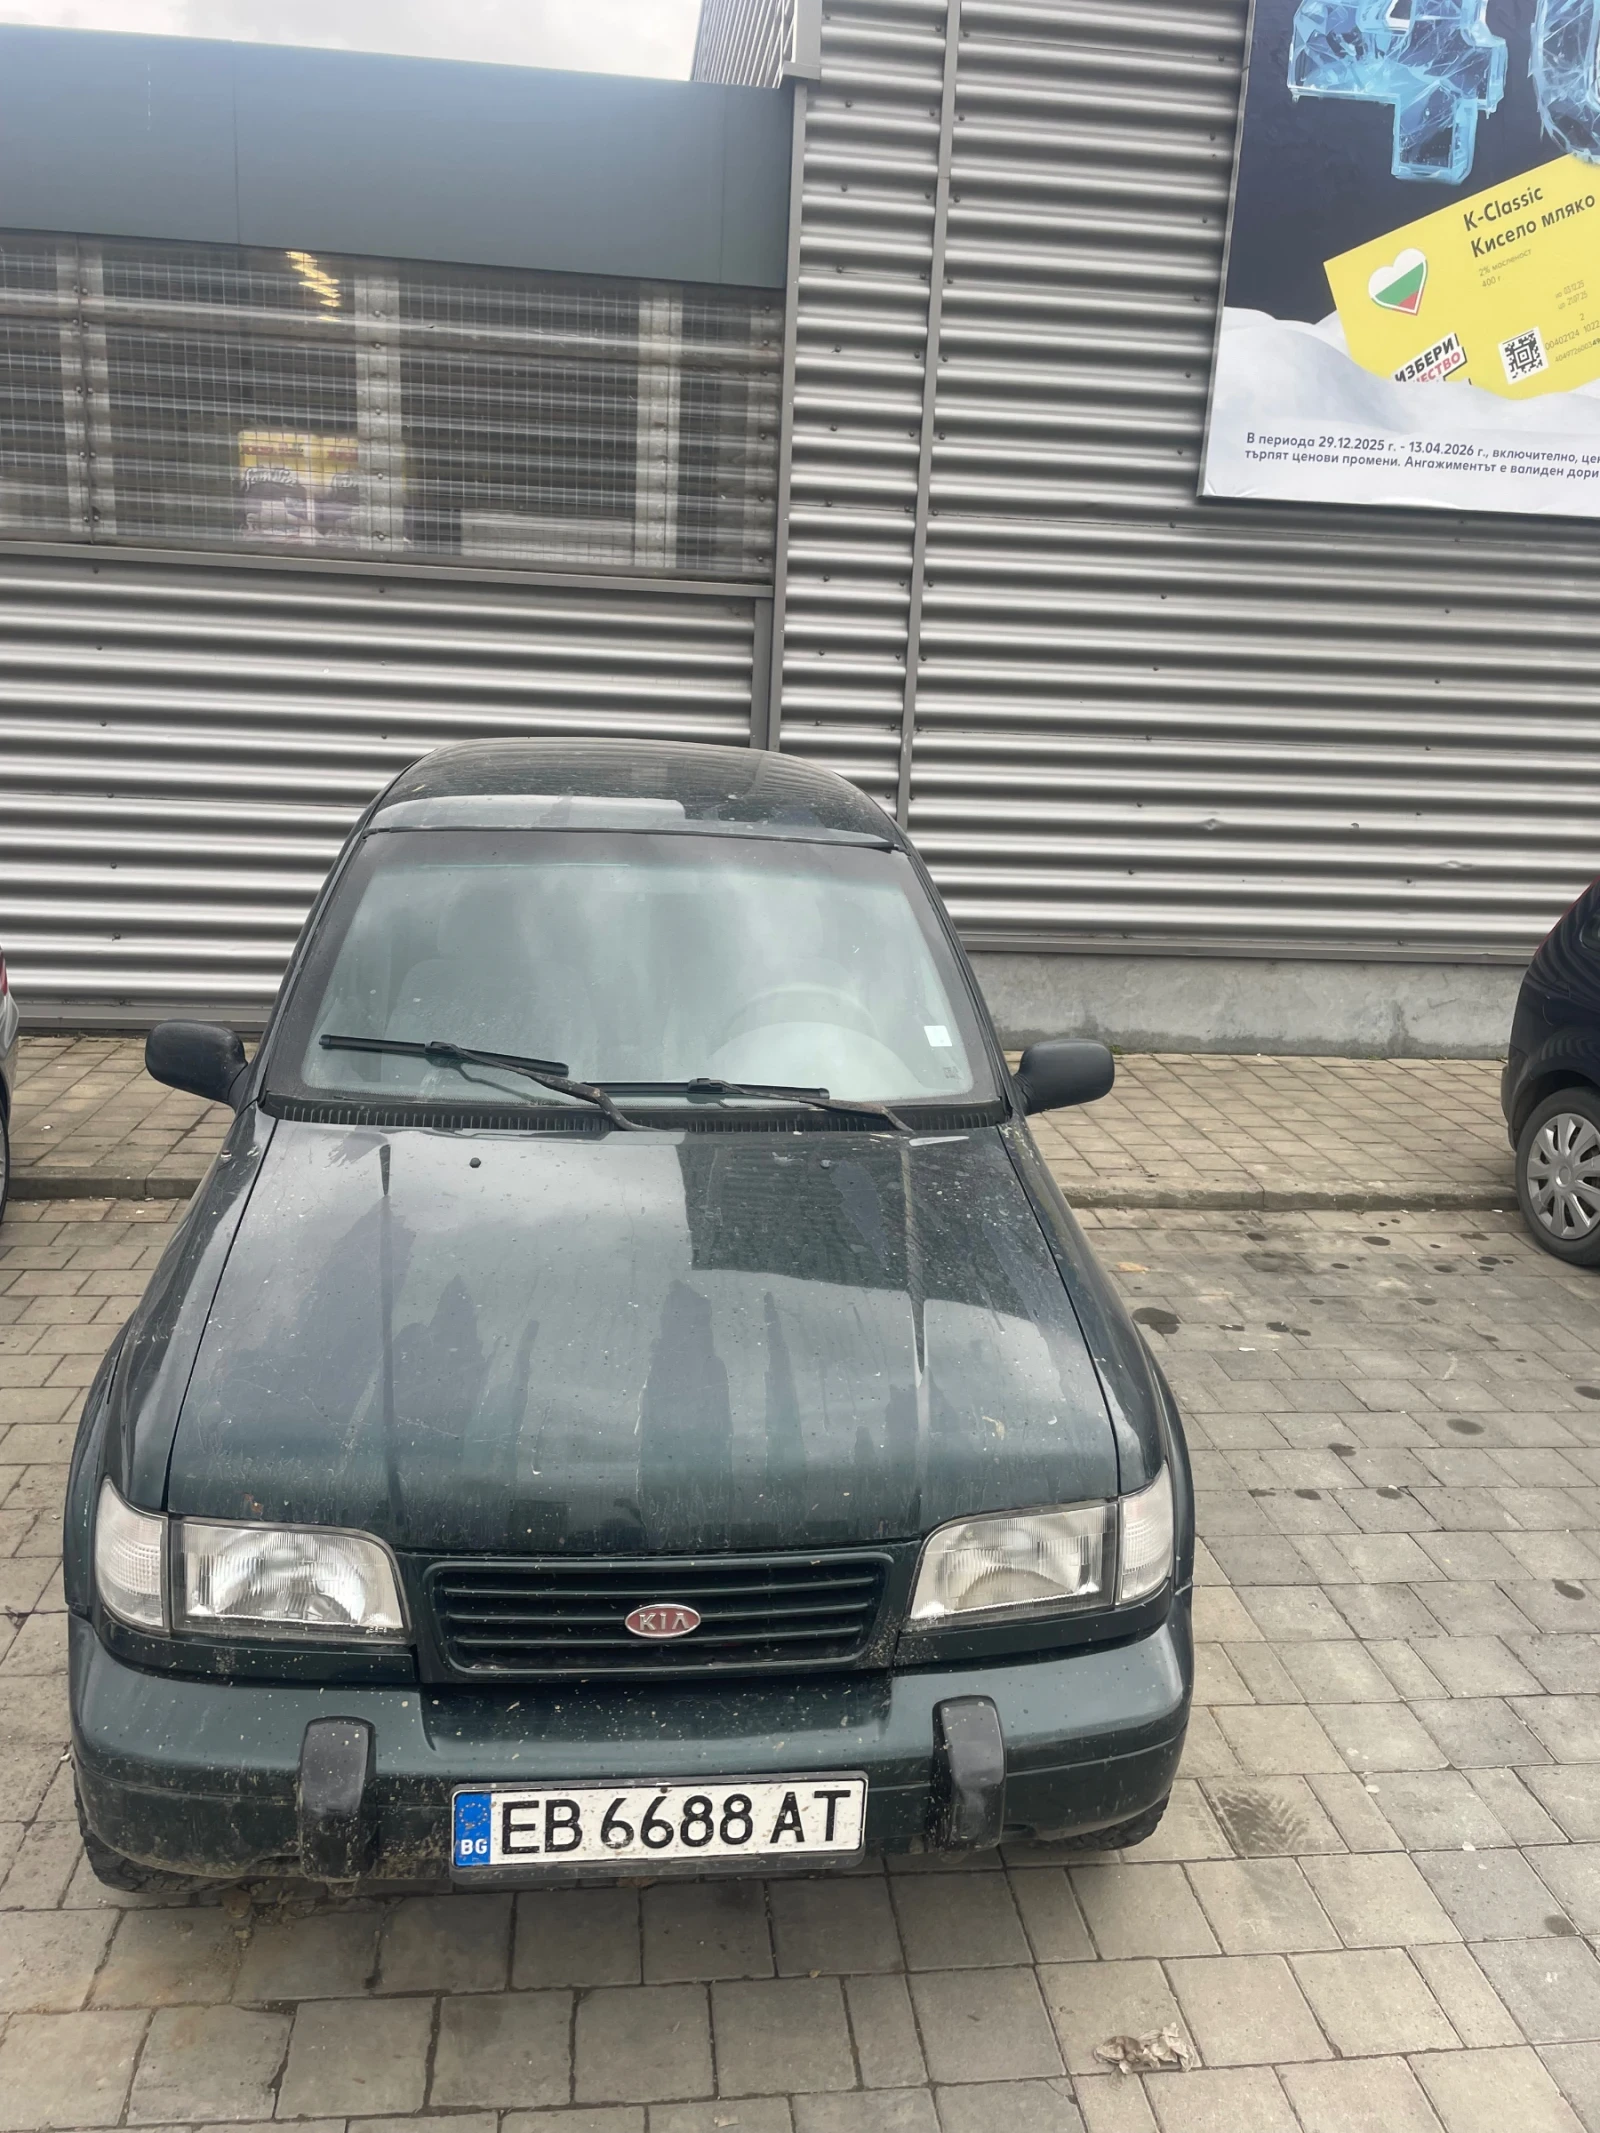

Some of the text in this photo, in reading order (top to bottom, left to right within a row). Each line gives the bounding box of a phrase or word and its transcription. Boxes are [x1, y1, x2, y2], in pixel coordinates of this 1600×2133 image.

[1463, 187, 1544, 231] K-Classic
[1471, 194, 1595, 258] Кисело мляко
[1481, 275, 1496, 288] 400
[1579, 313, 1585, 321] 2
[1395, 337, 1454, 382] ИЗБЕРИ
[1416, 351, 1461, 382] ЕСТВО
[1246, 432, 1255, 444] В
[1258, 434, 1315, 449] периода
[1318, 436, 1385, 451] 29.12.2025
[1387, 443, 1396, 451] г.
[1408, 441, 1474, 456] 13.04.2026
[1492, 449, 1578, 464] включително,
[1245, 450, 1599, 480] търпят ценови промени. Ангажиментът е валиден дори
[639, 1611, 690, 1631] KIA
[502, 1789, 851, 1854] EB 6688 AT
[461, 1839, 488, 1855] BG
